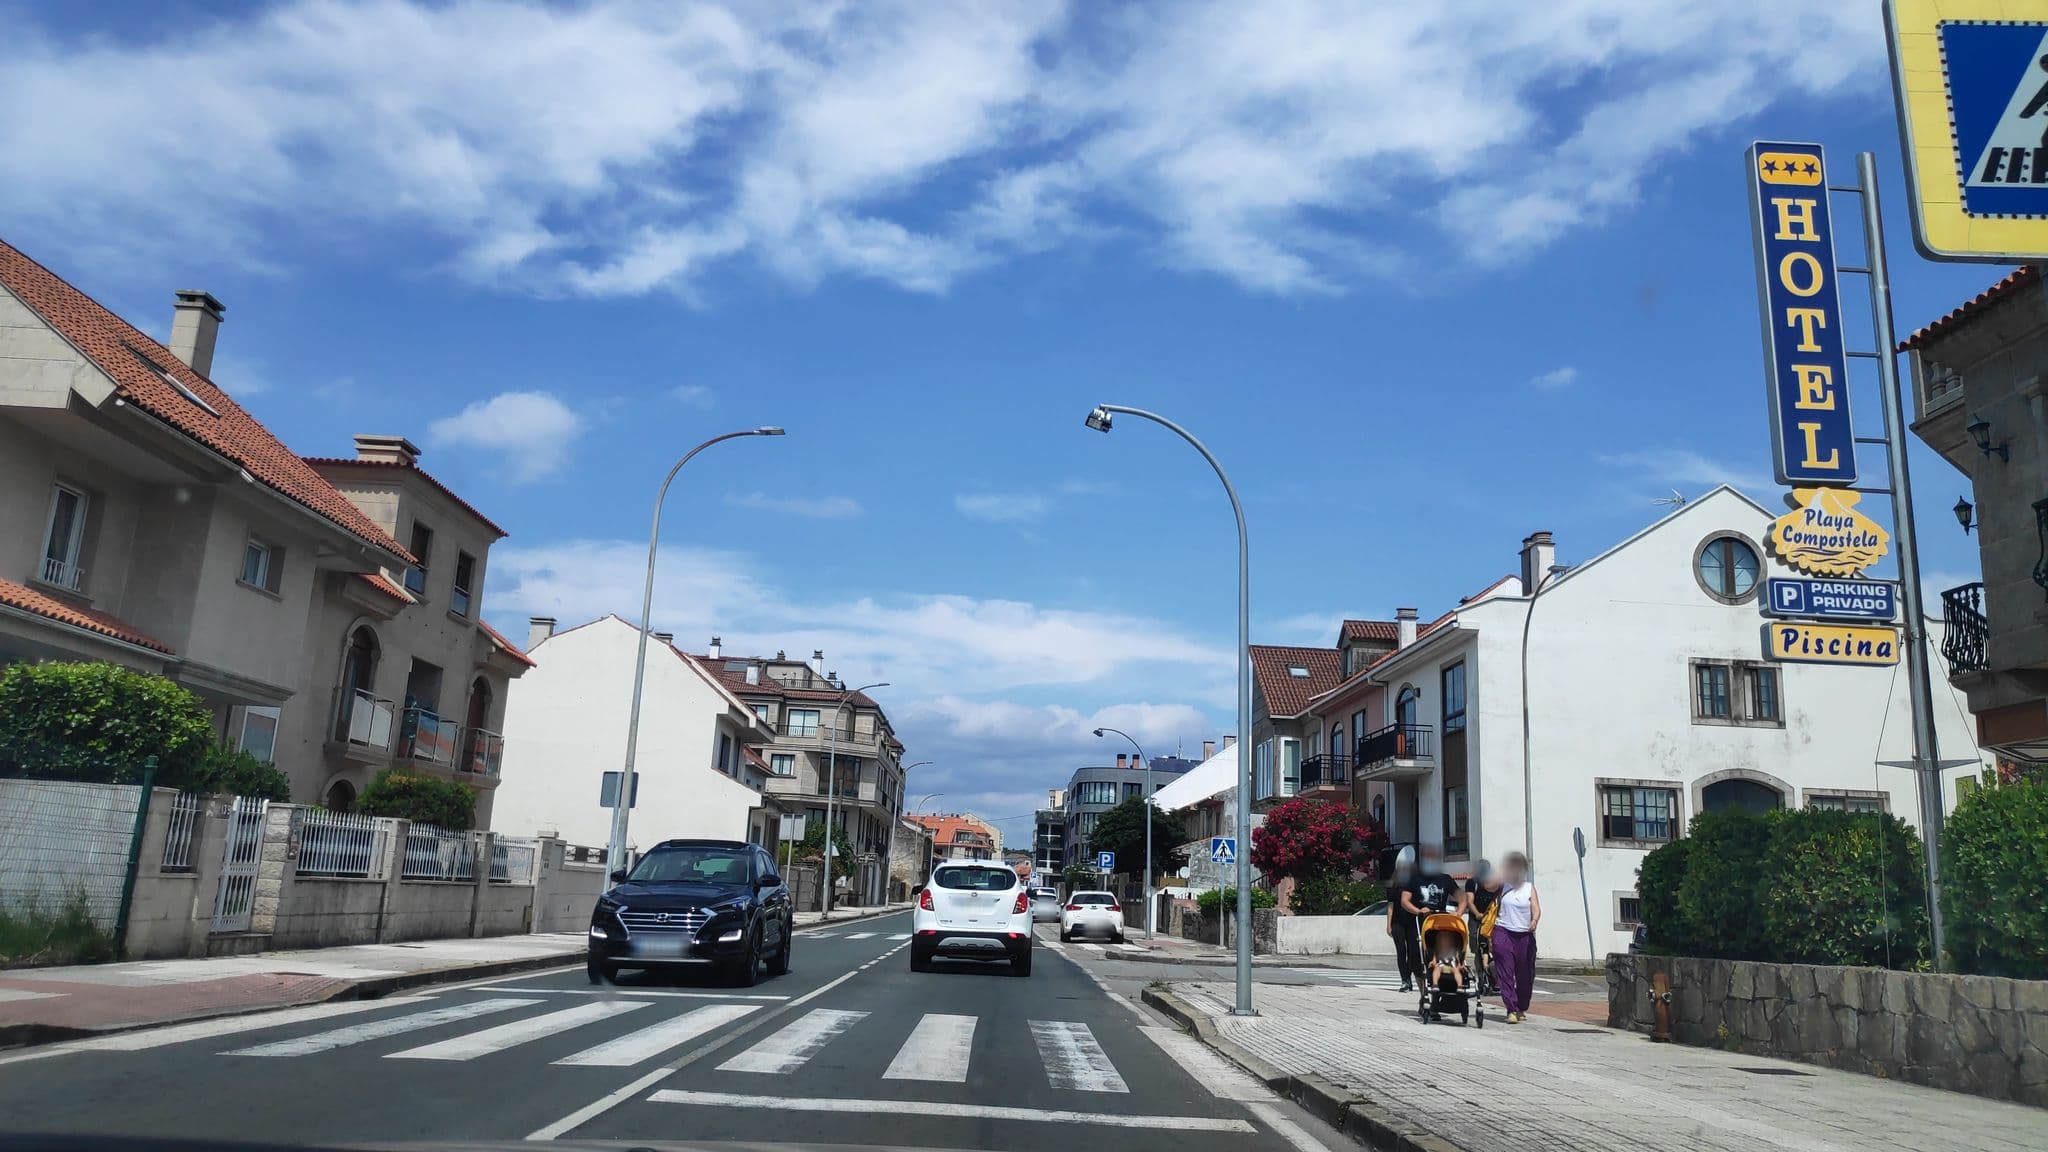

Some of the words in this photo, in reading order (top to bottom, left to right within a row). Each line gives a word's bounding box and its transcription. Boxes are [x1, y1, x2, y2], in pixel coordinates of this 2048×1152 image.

[1771, 197, 1840, 470] HOTEL
[1804, 508, 1854, 531] Playa
[1782, 525, 1878, 549] Compostela
[1782, 586, 1798, 606] P
[1811, 582, 1887, 597] PARKING
[1813, 596, 1888, 610] PRIVADO
[1780, 628, 1892, 658] Piscina
[1101, 854, 1111, 866] P
